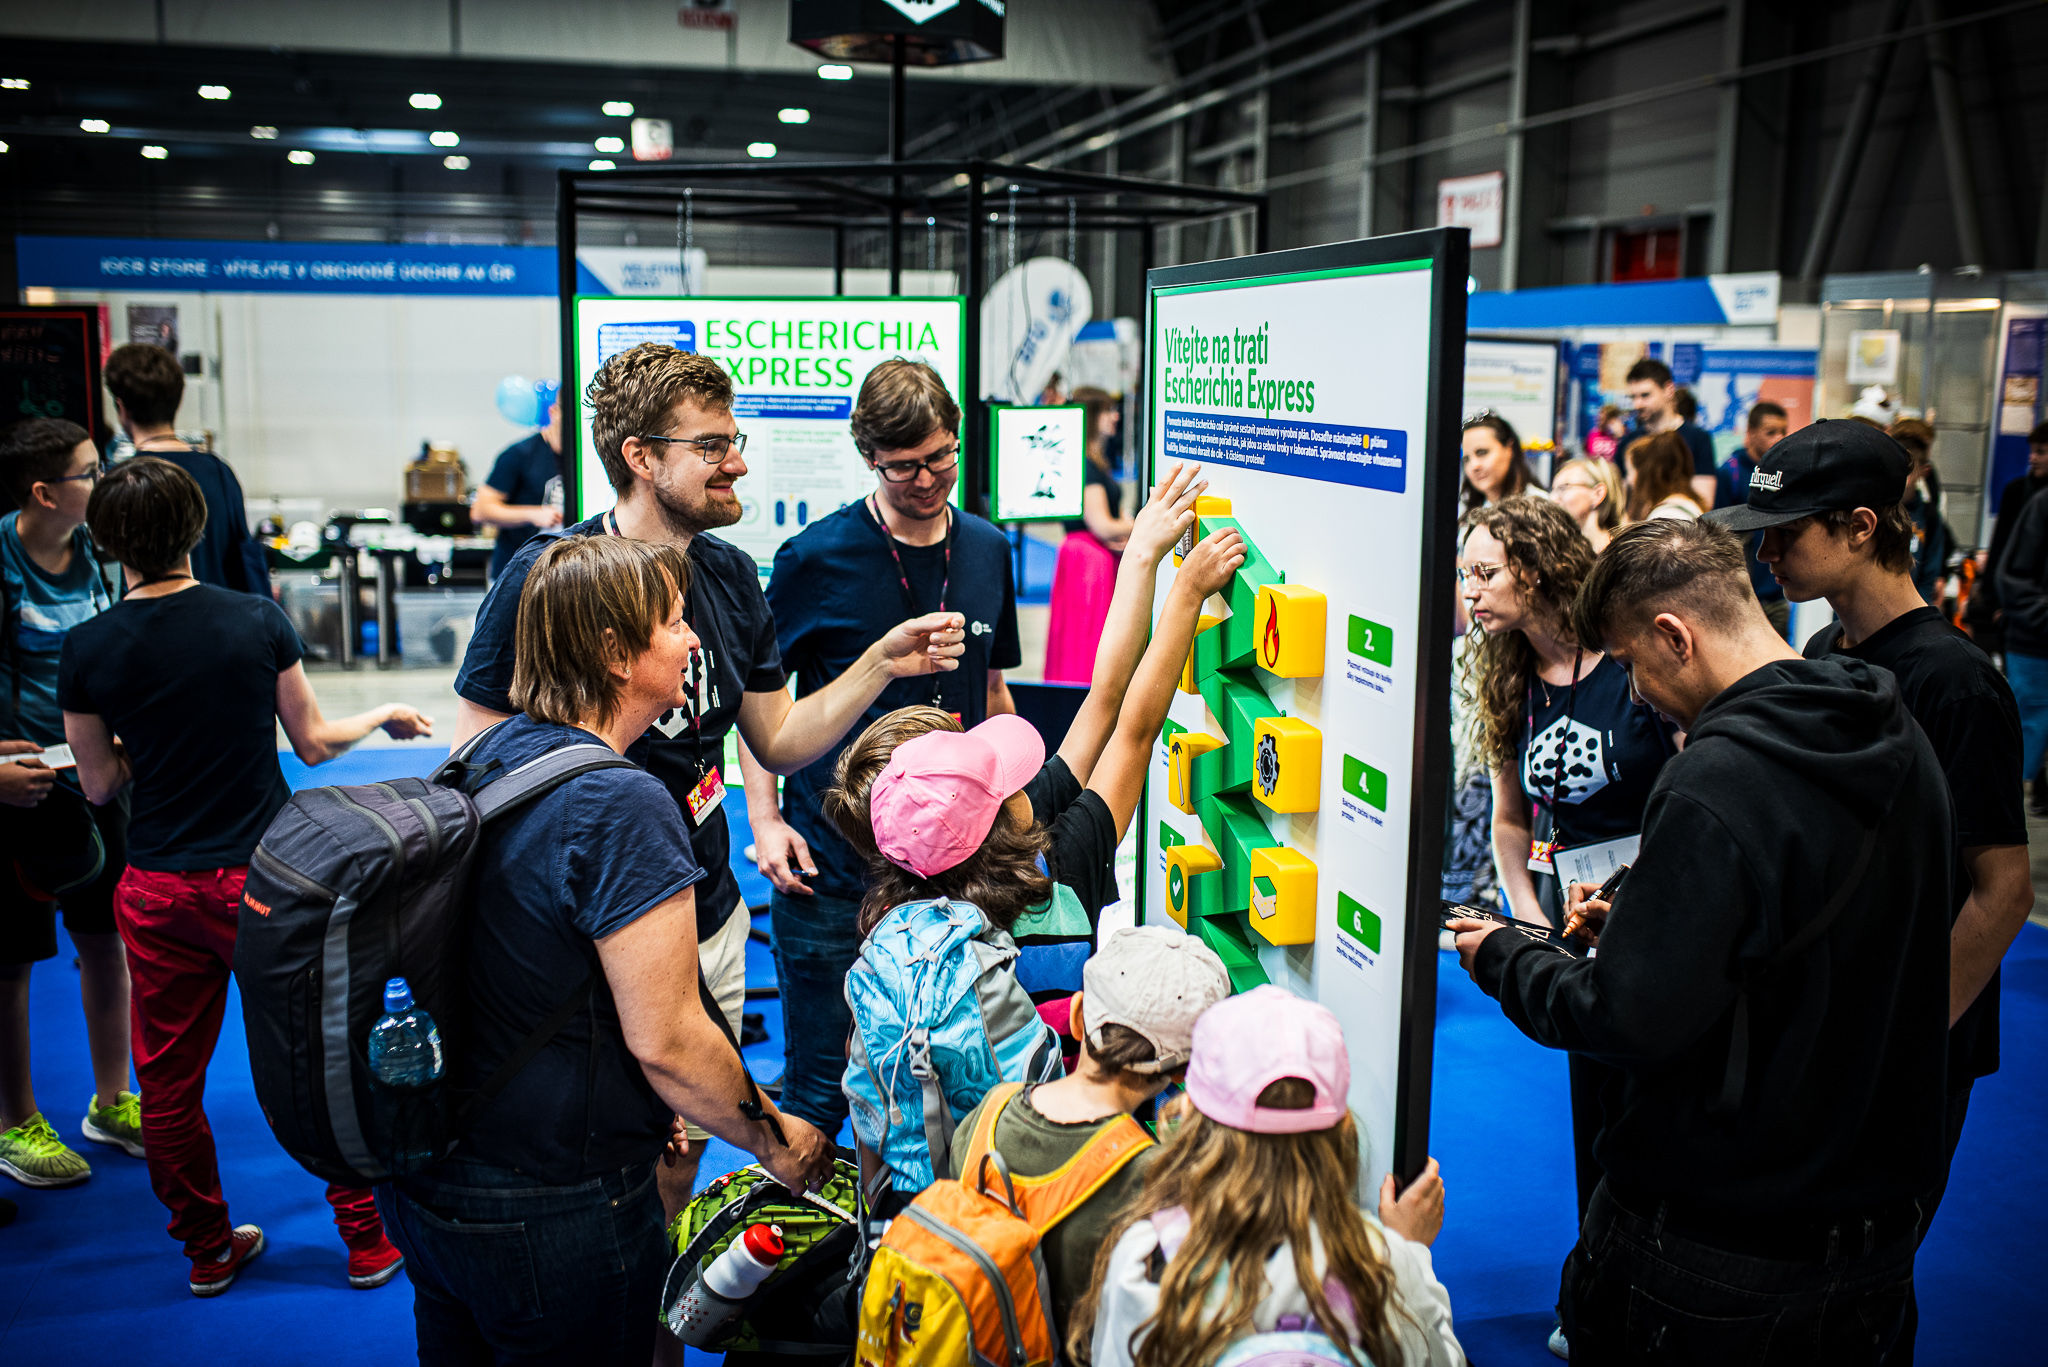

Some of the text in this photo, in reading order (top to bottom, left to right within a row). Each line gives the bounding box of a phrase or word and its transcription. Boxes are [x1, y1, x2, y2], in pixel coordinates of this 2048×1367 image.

[150, 258, 208, 277] STORE
[706, 320, 939, 352] ESCHERICHIA
[1165, 321, 1269, 374] Vítejte na trati
[711, 357, 853, 388] XPRESS
[1165, 367, 1315, 419] Escherichia Express
[1240, 422, 1256, 435] sestavit
[1256, 424, 1279, 439] proteinový
[1320, 447, 1346, 461] Správnost
[1364, 628, 1375, 652] 2.
[1358, 771, 1370, 795] 4.
[1353, 910, 1364, 935] 6.
